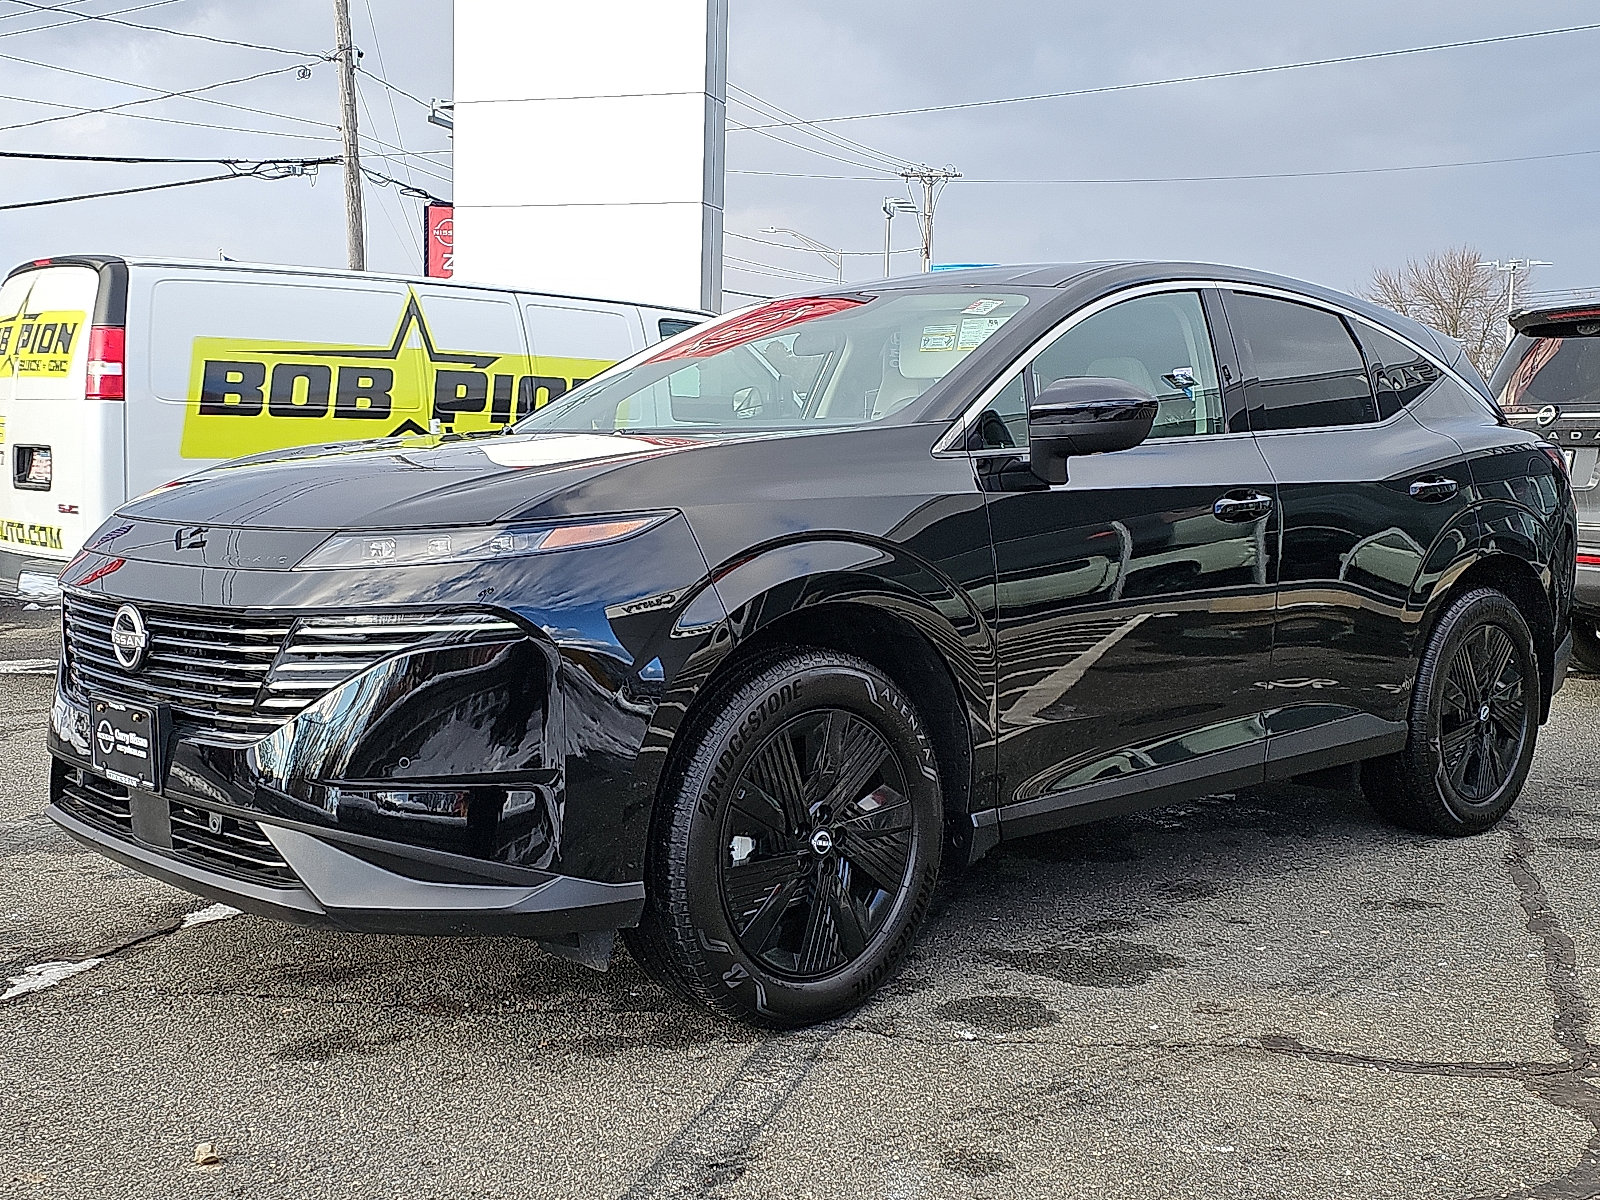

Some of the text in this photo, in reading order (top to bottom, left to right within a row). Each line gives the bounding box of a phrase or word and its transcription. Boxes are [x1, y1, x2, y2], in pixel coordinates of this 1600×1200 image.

[13, 323, 78, 356] PION
[199, 360, 586, 424] BOB PIO
[697, 679, 802, 821] BRIDGESTONE
[880, 687, 931, 761] ALENZA
